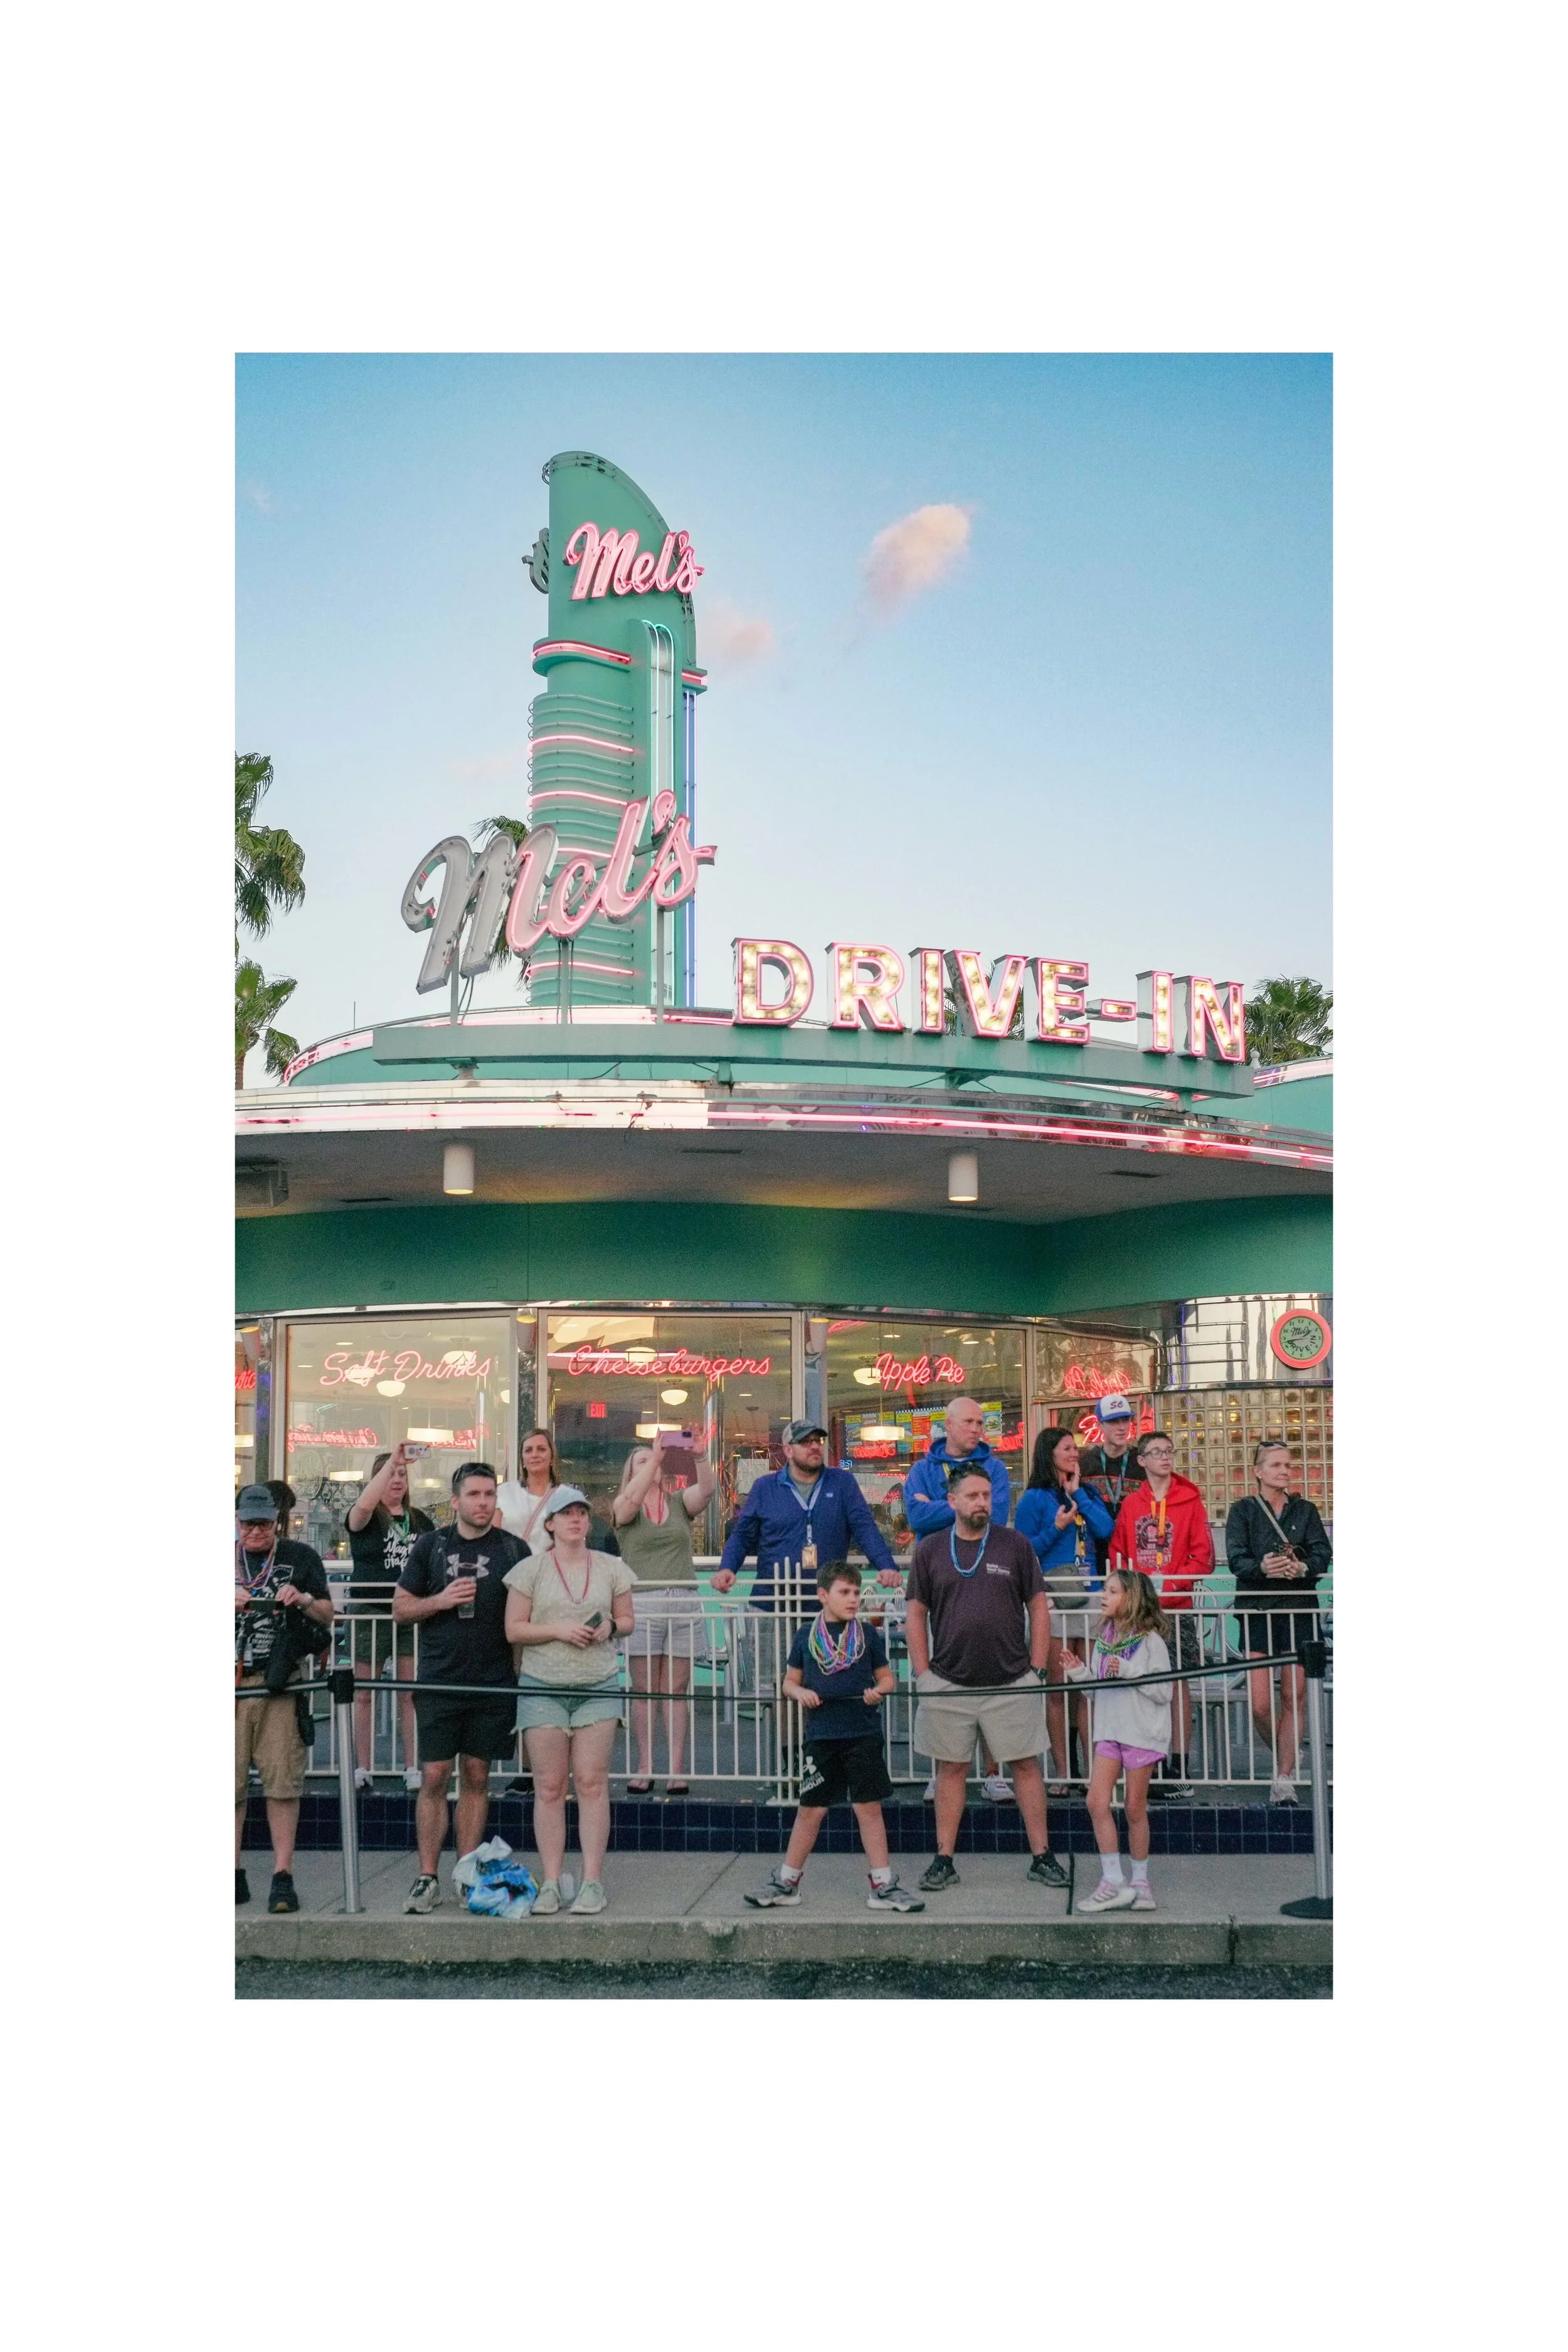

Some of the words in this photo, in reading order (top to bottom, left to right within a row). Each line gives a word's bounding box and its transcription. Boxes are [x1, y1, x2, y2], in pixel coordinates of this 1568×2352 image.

[563, 521, 704, 600] Mel's
[401, 789, 717, 995] Mel's
[731, 937, 1246, 1064] DRIVE-IN
[320, 1350, 389, 1387] Soft
[393, 1350, 492, 1382] Drinks
[568, 1344, 771, 1382] Cheeseburgers
[874, 1352, 931, 1391] Apple
[933, 1355, 965, 1384] Pie
[591, 1403, 606, 1417] EXIT
